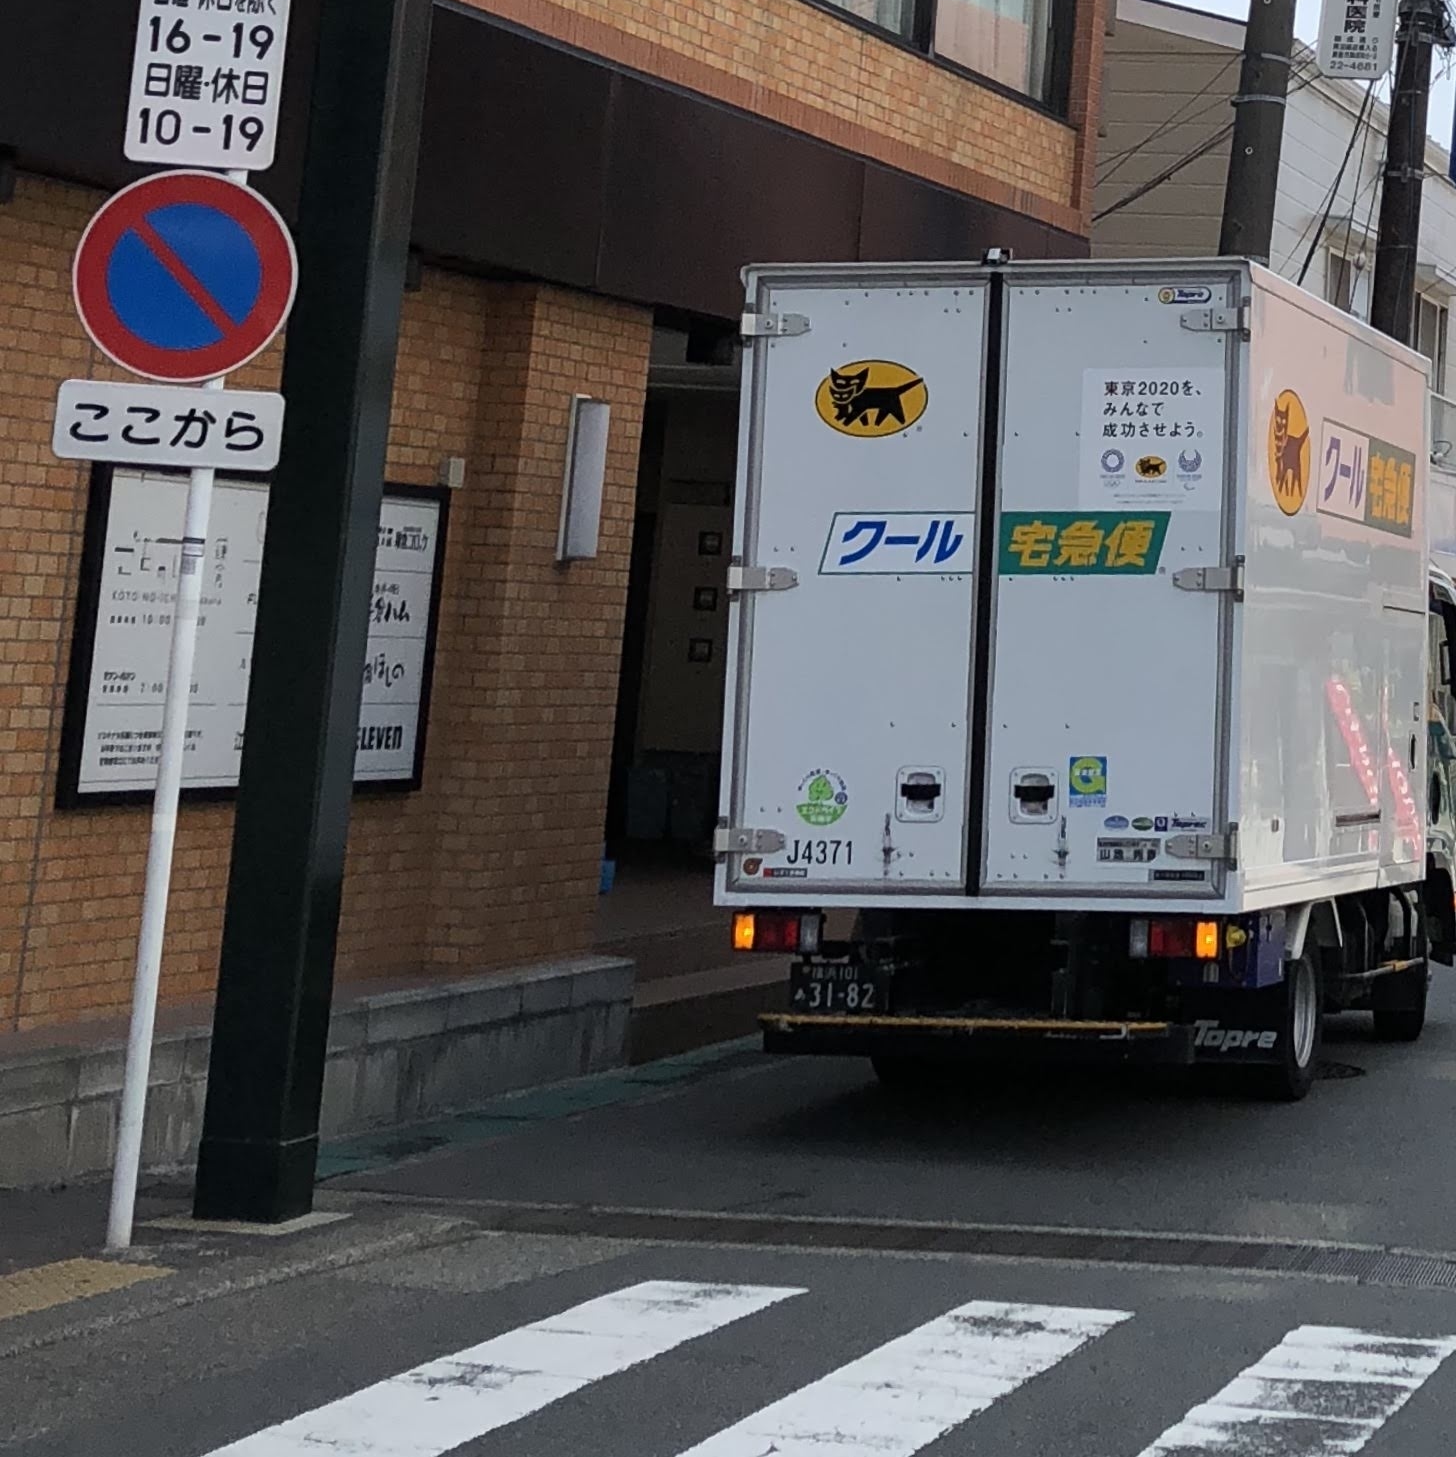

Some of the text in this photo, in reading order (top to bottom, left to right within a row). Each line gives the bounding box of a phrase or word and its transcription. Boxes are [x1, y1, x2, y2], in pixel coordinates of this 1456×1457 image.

[148, 15, 275, 61] 16-19
[144, 63, 270, 106] 日曜・休日
[137, 107, 266, 153] 10-19
[1103, 380, 1203, 397] 東京2020を、
[68, 402, 265, 451] ここから
[1103, 402, 1164, 417] みんなで
[1102, 422, 1204, 438] 成功させよう。
[1324, 436, 1412, 525] クール 宅急便
[841, 519, 1155, 568] クール 宅急便
[787, 840, 853, 865] J4371
[809, 982, 874, 1008] 31-82
[1194, 1019, 1278, 1052] Topre
